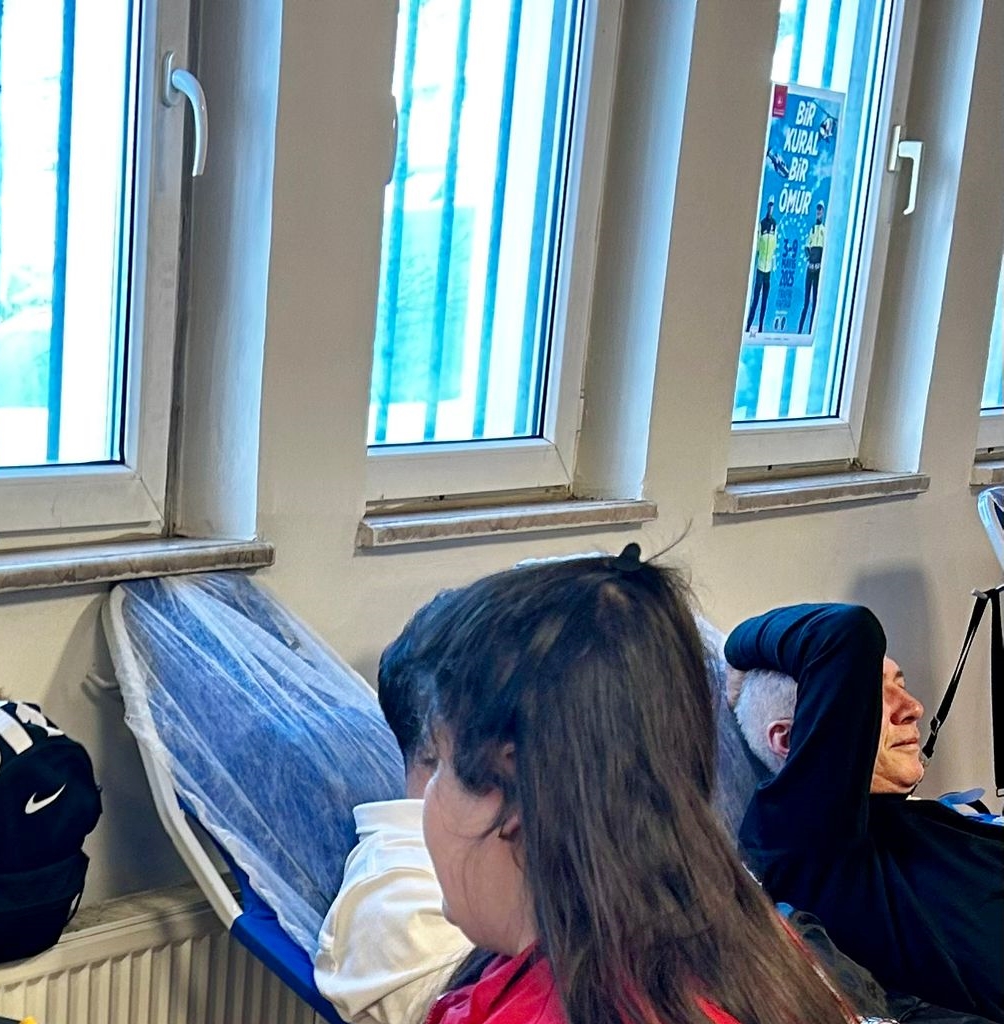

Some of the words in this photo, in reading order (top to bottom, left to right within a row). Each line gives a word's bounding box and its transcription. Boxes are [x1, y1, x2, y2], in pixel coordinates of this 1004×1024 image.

[783, 127, 820, 157] KURAL
[778, 182, 813, 216] ÖMÜR
[782, 238, 799, 259] 3-9
